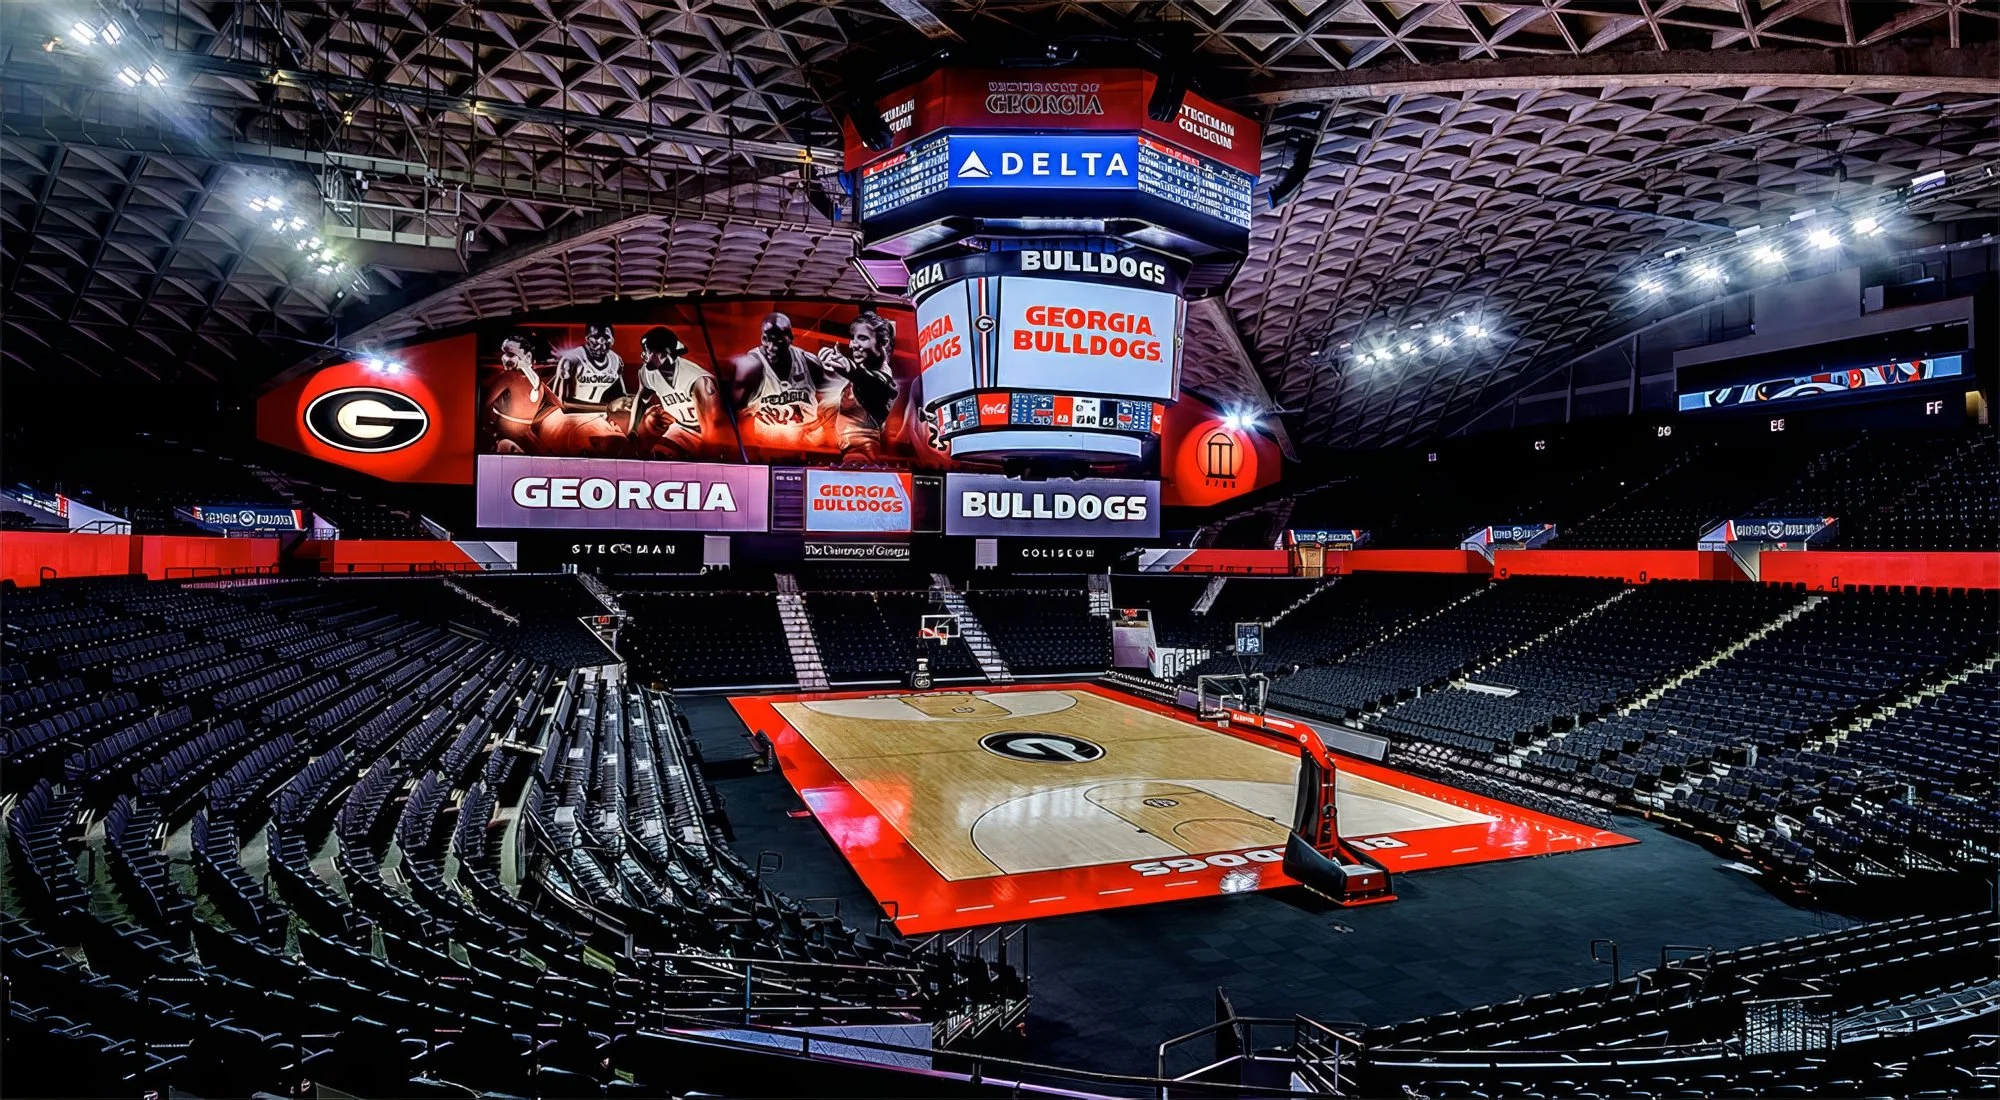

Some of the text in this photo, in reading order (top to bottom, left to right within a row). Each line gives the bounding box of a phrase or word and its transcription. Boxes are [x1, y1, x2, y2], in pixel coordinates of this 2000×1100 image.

[985, 93, 1104, 115] GEORGIA
[1002, 152, 1129, 176] DELTA
[1021, 250, 1166, 285] BULLDOGS
[1025, 305, 1153, 336] GEORGIA
[1013, 329, 1162, 363] BULLDOGS
[1926, 400, 1943, 415] FF
[511, 476, 737, 513] GEORGIA
[819, 485, 900, 498] GEORGIA
[813, 499, 903, 512] BULLDOGS
[961, 491, 1148, 521] BULLDOGS
